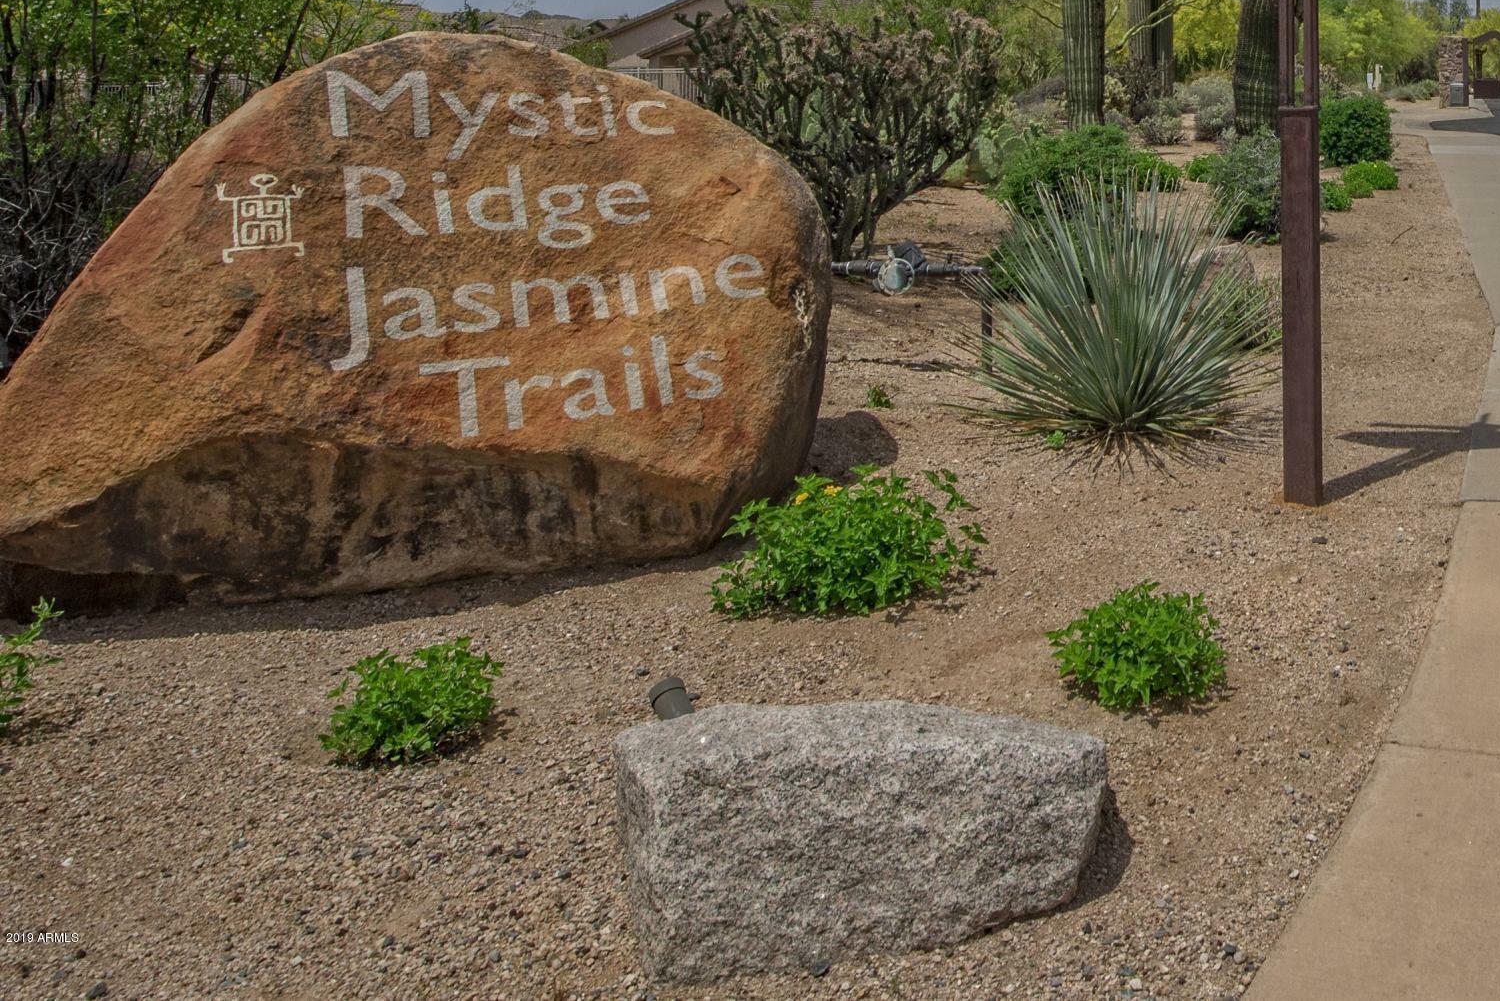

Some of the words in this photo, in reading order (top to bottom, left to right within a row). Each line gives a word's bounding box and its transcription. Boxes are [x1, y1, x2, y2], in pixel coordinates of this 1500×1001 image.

[326, 70, 675, 160] Mystic
[343, 165, 651, 249] Ridge
[330, 253, 766, 373] Jasmine
[419, 335, 725, 438] Trails
